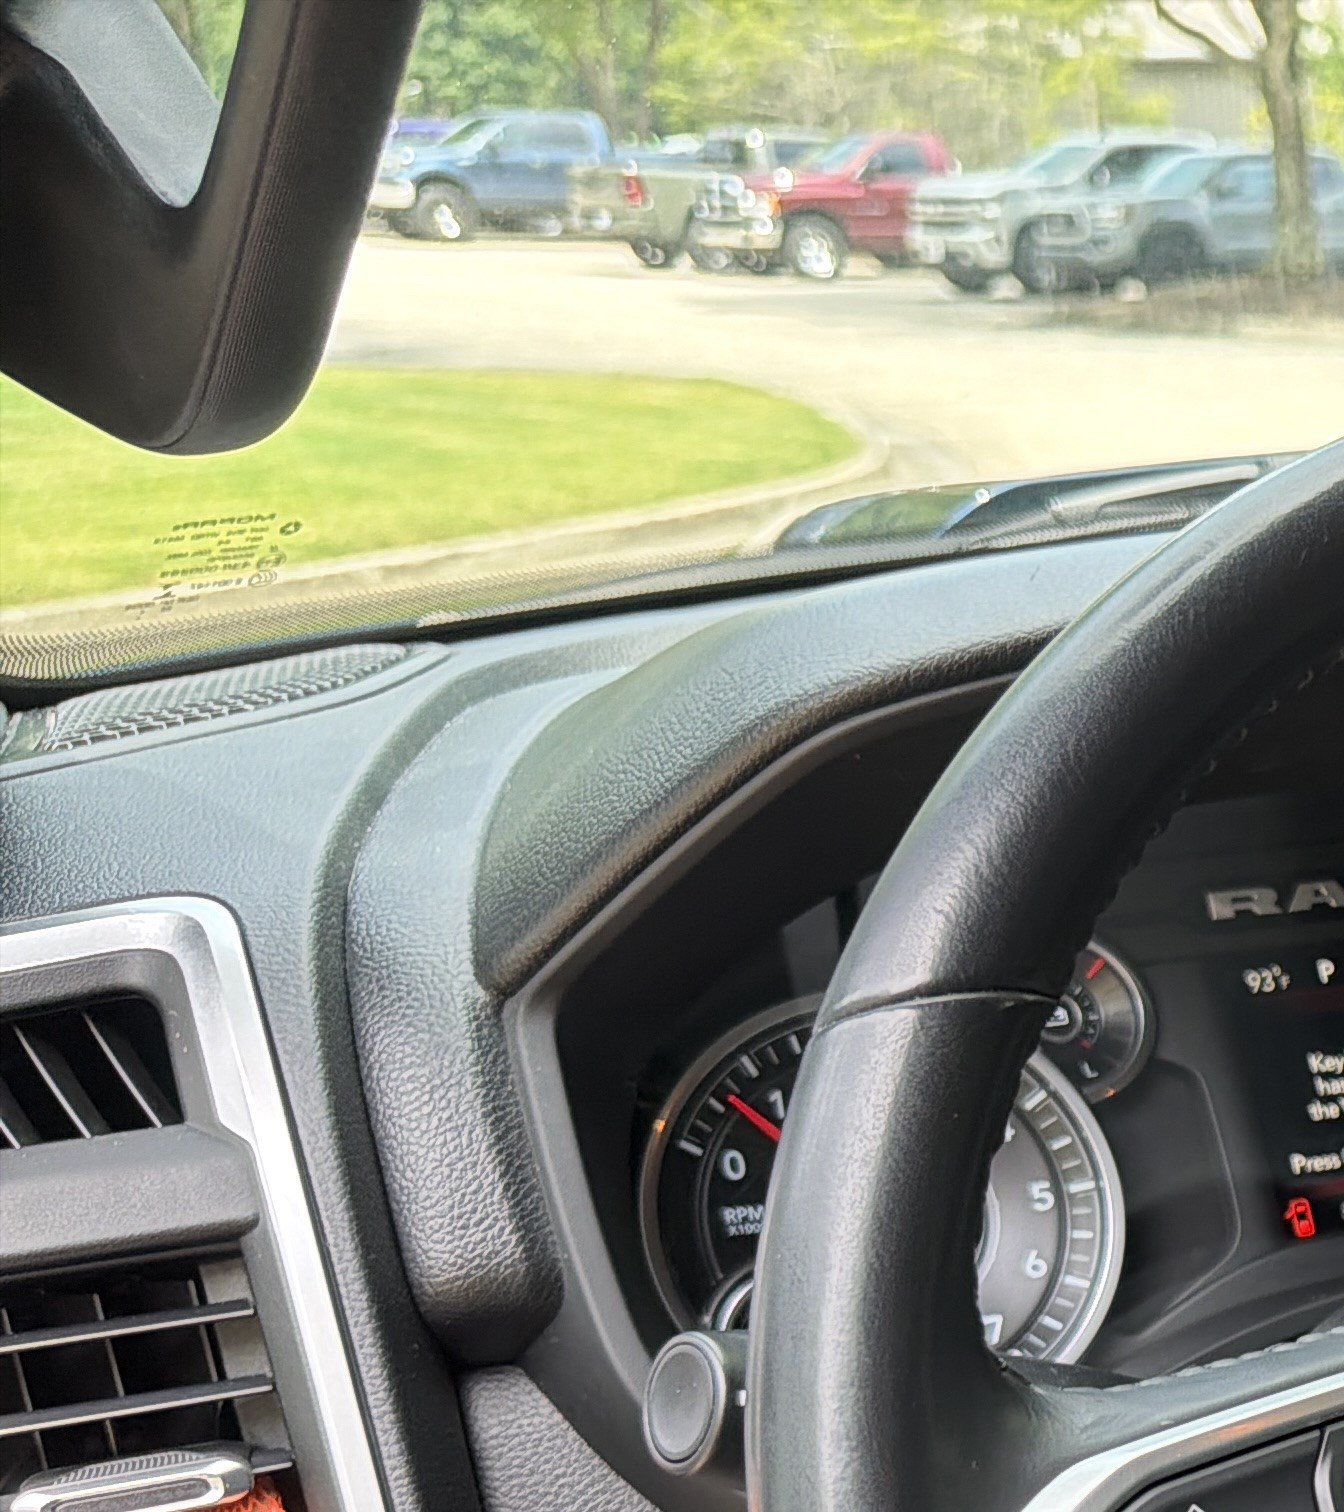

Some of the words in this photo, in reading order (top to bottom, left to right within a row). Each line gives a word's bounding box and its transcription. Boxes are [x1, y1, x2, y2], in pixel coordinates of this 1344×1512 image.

[1315, 958, 1335, 985] P
[1306, 1051, 1344, 1074] Key
[767, 1088, 786, 1120] 1
[1306, 1098, 1340, 1122] the
[721, 1149, 746, 1181] 0
[1289, 1152, 1342, 1175] Press
[1026, 1178, 1055, 1212] 5
[1026, 1249, 1049, 1279] 6
